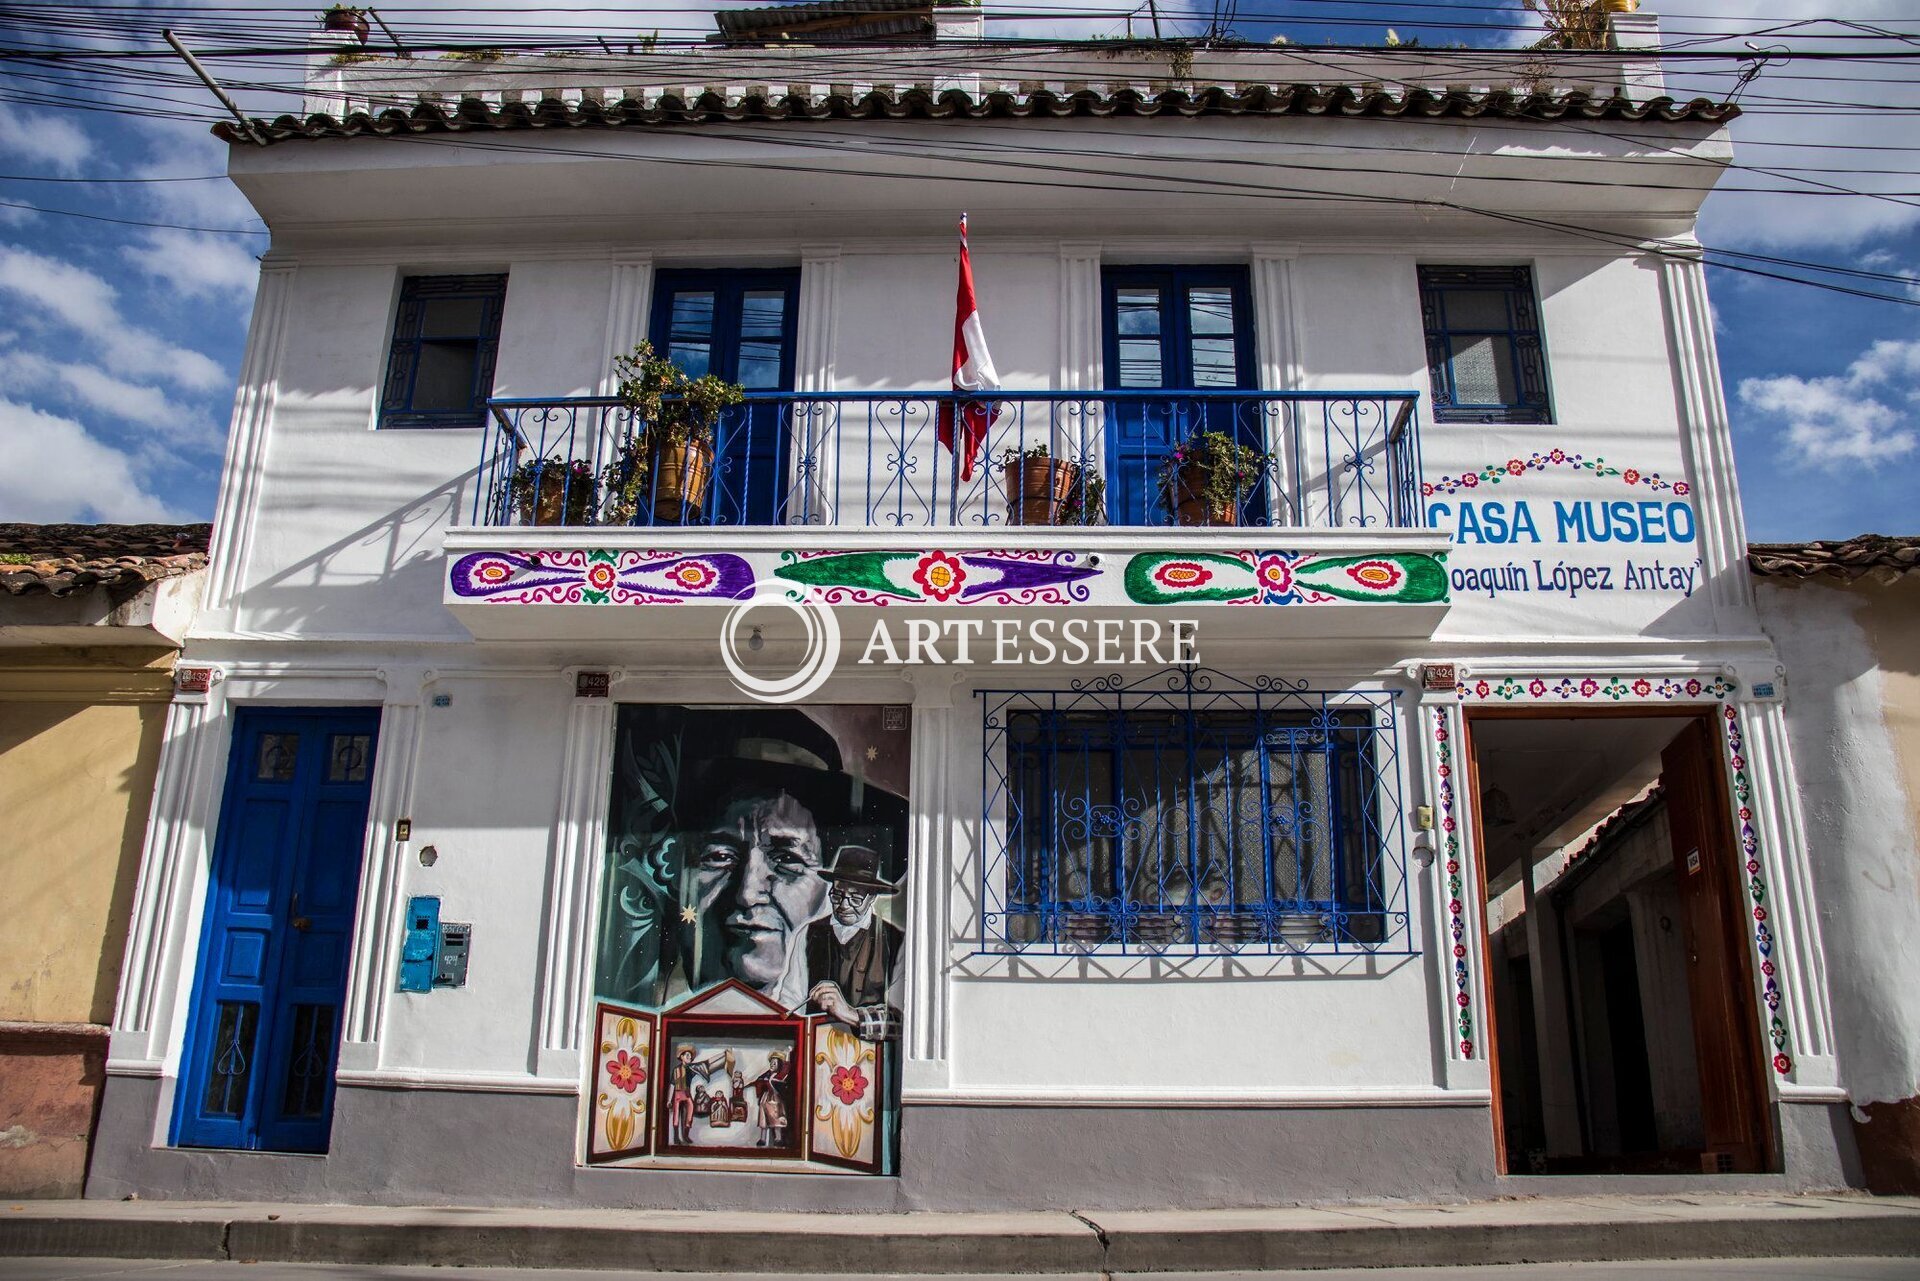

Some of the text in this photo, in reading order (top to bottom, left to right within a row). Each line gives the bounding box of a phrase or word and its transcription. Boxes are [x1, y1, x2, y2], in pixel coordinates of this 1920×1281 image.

[1428, 501, 1696, 543] CASA MUSEO
[1451, 561, 1530, 598] oaquín
[1533, 559, 1613, 598] López
